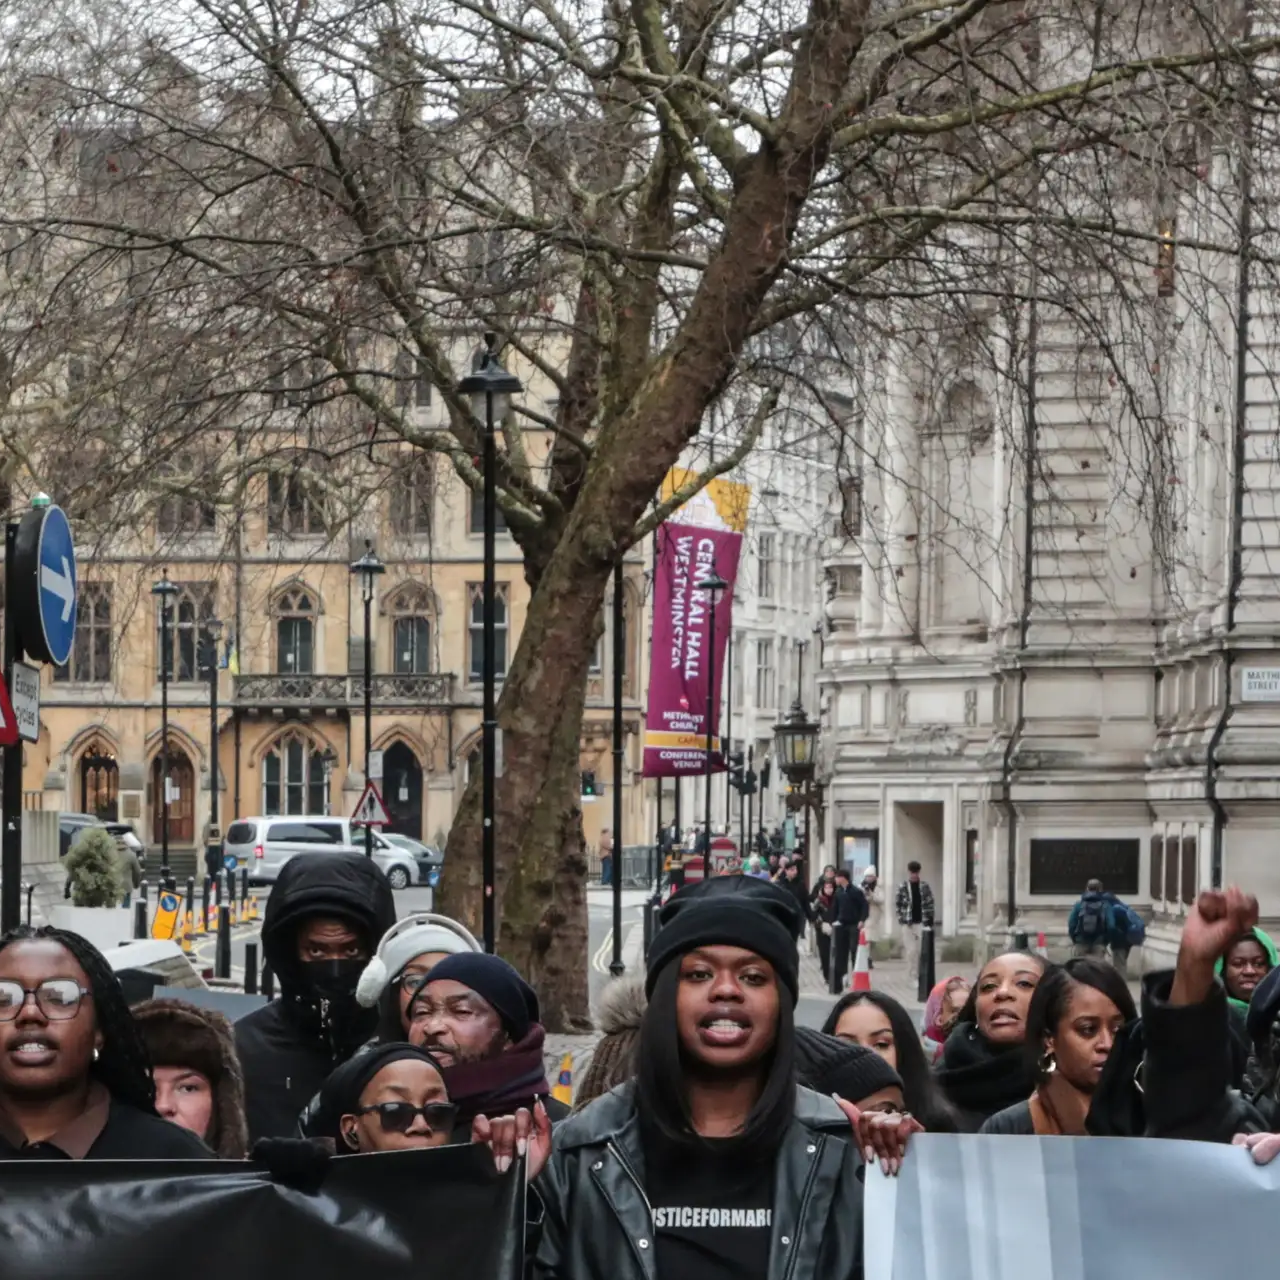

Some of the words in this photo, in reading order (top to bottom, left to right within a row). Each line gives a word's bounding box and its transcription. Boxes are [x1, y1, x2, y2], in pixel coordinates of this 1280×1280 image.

[685, 630, 703, 680] HALL
[1247, 681, 1279, 690] STREET
[673, 760, 702, 769] VENUE
